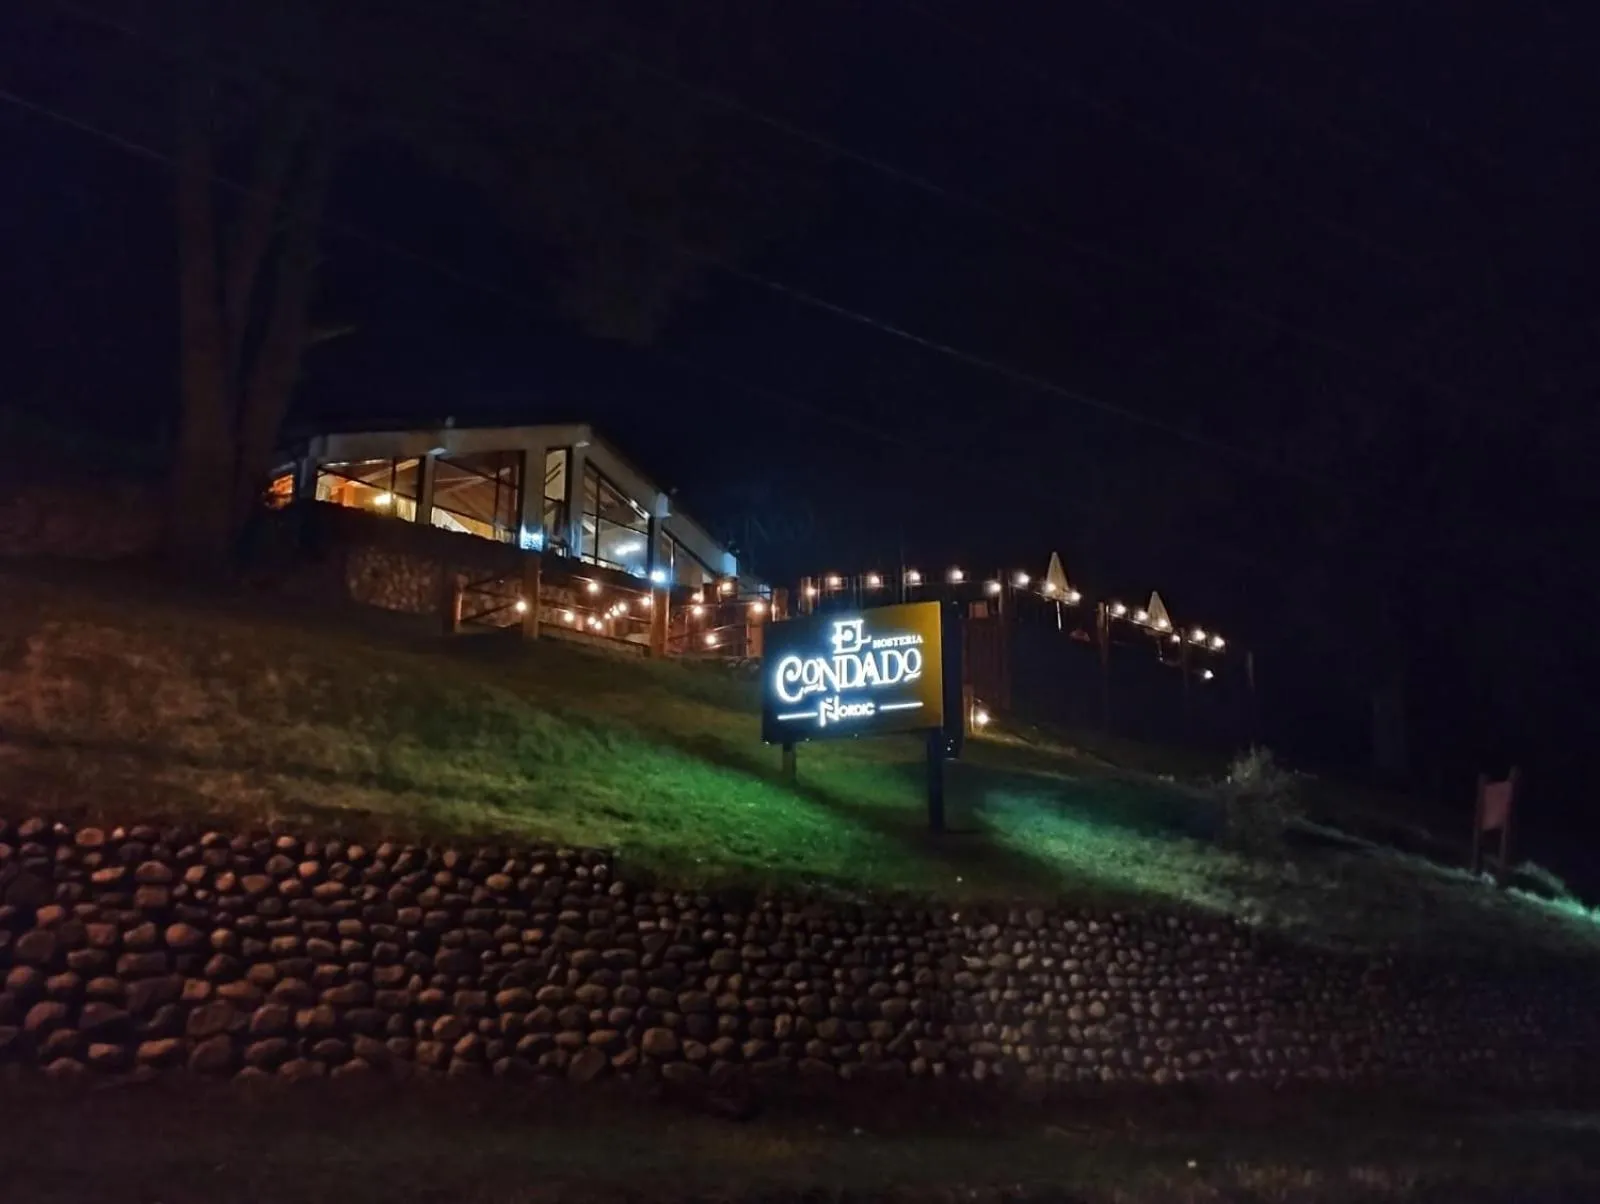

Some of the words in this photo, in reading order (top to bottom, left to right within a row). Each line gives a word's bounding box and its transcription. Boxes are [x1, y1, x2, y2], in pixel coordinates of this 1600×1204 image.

[832, 619, 871, 653] EL
[873, 634, 923, 649] HOSTERIA
[776, 648, 922, 702] CONDADO
